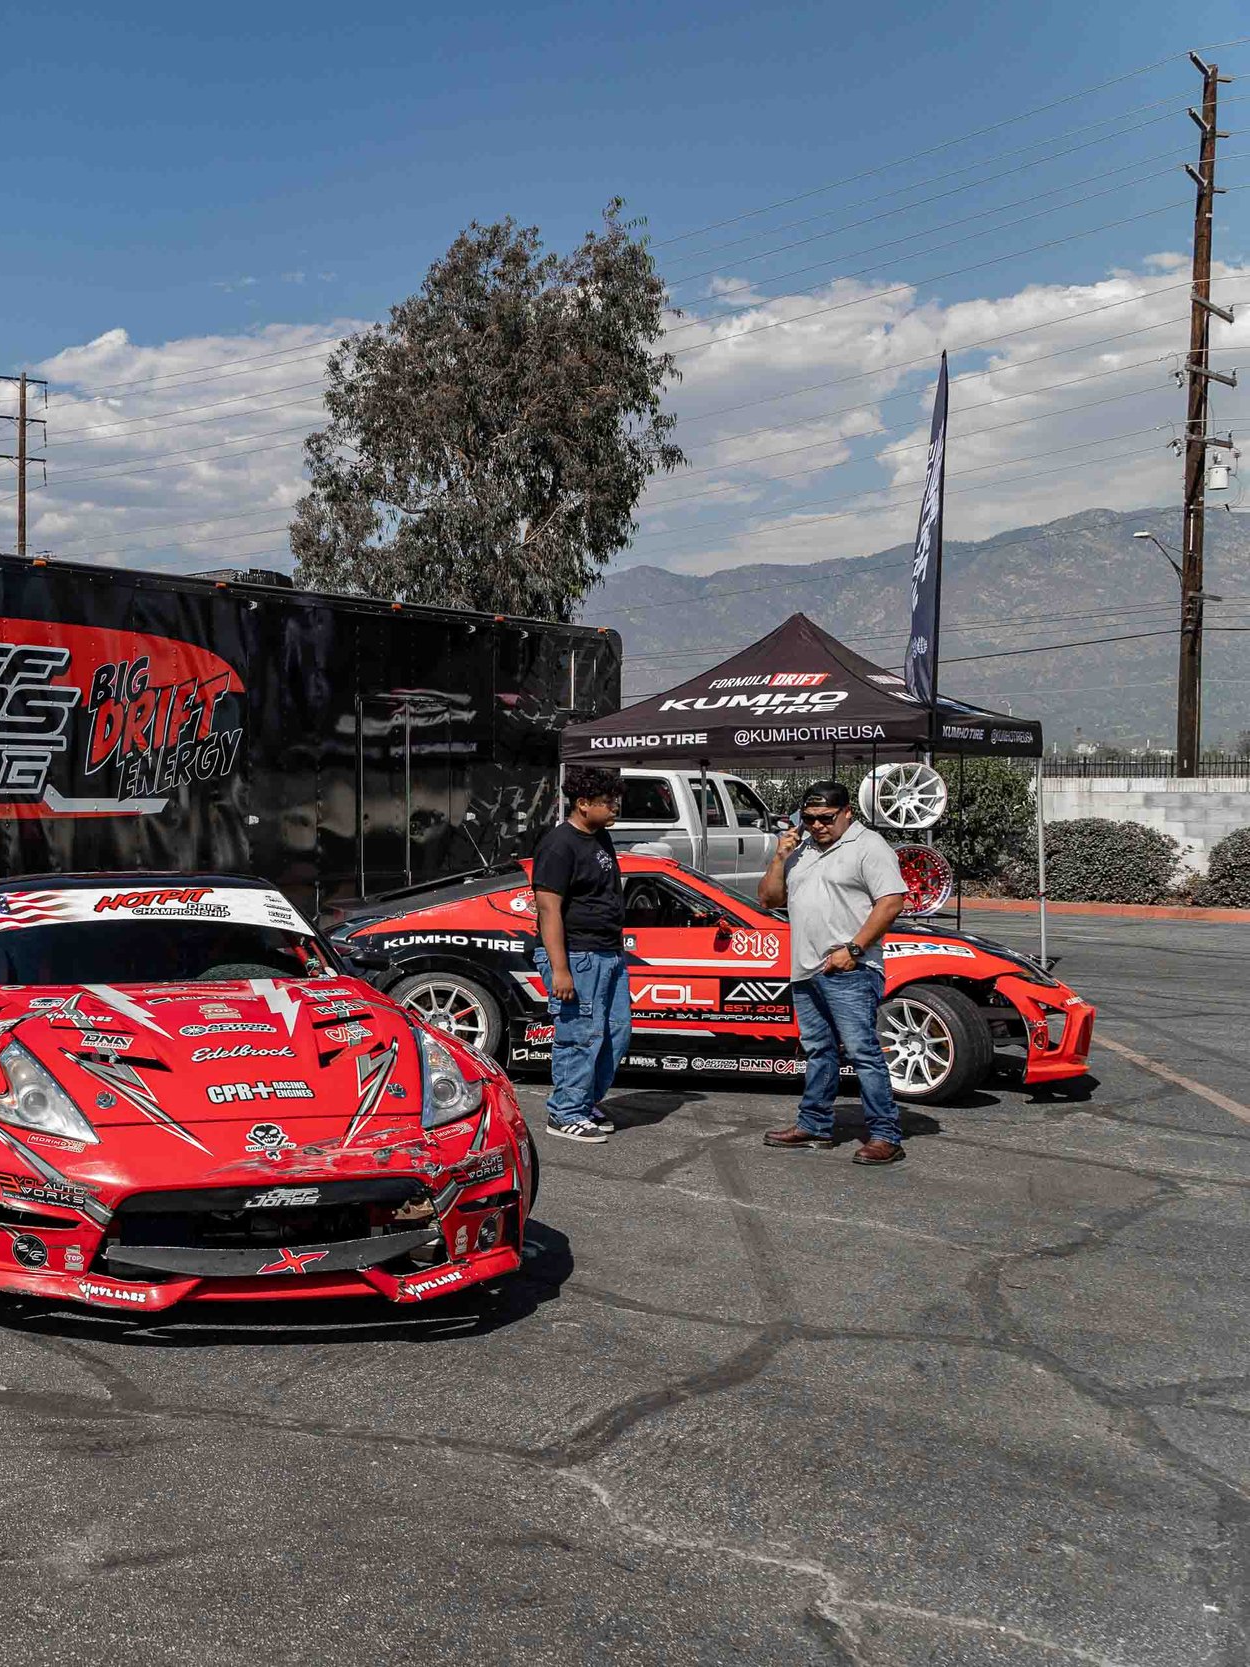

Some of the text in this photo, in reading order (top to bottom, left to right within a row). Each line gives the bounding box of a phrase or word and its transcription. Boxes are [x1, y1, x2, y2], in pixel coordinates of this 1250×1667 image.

[88, 655, 150, 714] BIG
[708, 672, 827, 690] FORMULA DRIFT
[658, 691, 849, 712] KUMHO
[750, 702, 840, 716] TIRE
[85, 672, 231, 776] DRIFT
[590, 732, 708, 749] KUMHO TIRE
[734, 724, 886, 746] @KUMHOTIREUSA
[942, 725, 985, 741] KUMHO TIRE
[118, 728, 244, 802] ENERGY
[94, 888, 214, 913] HOTPIT
[187, 902, 229, 911] DRIFT
[132, 907, 231, 918] CHAMPIONSHIP
[383, 934, 525, 953] KUMHO TIRE
[731, 929, 780, 960] 818
[631, 1011, 666, 1019] UALITY
[701, 1013, 791, 1022] PERFORMANCE
[724, 1004, 790, 1013] EST. 2021
[84, 1033, 131, 1046] DNA
[190, 1044, 297, 1063] Edelbrock
[740, 1059, 771, 1067] DNA
[272, 1081, 308, 1089] RACING
[275, 1088, 315, 1099] ENGINES
[480, 1155, 504, 1167] AUTO
[468, 1163, 504, 1179] WORKS
[20, 1186, 84, 1204] WORKS
[42, 1180, 85, 1195] AUTO
[78, 1282, 147, 1303] VINYL LABZ
[405, 1271, 463, 1300] VINYL LABZ
